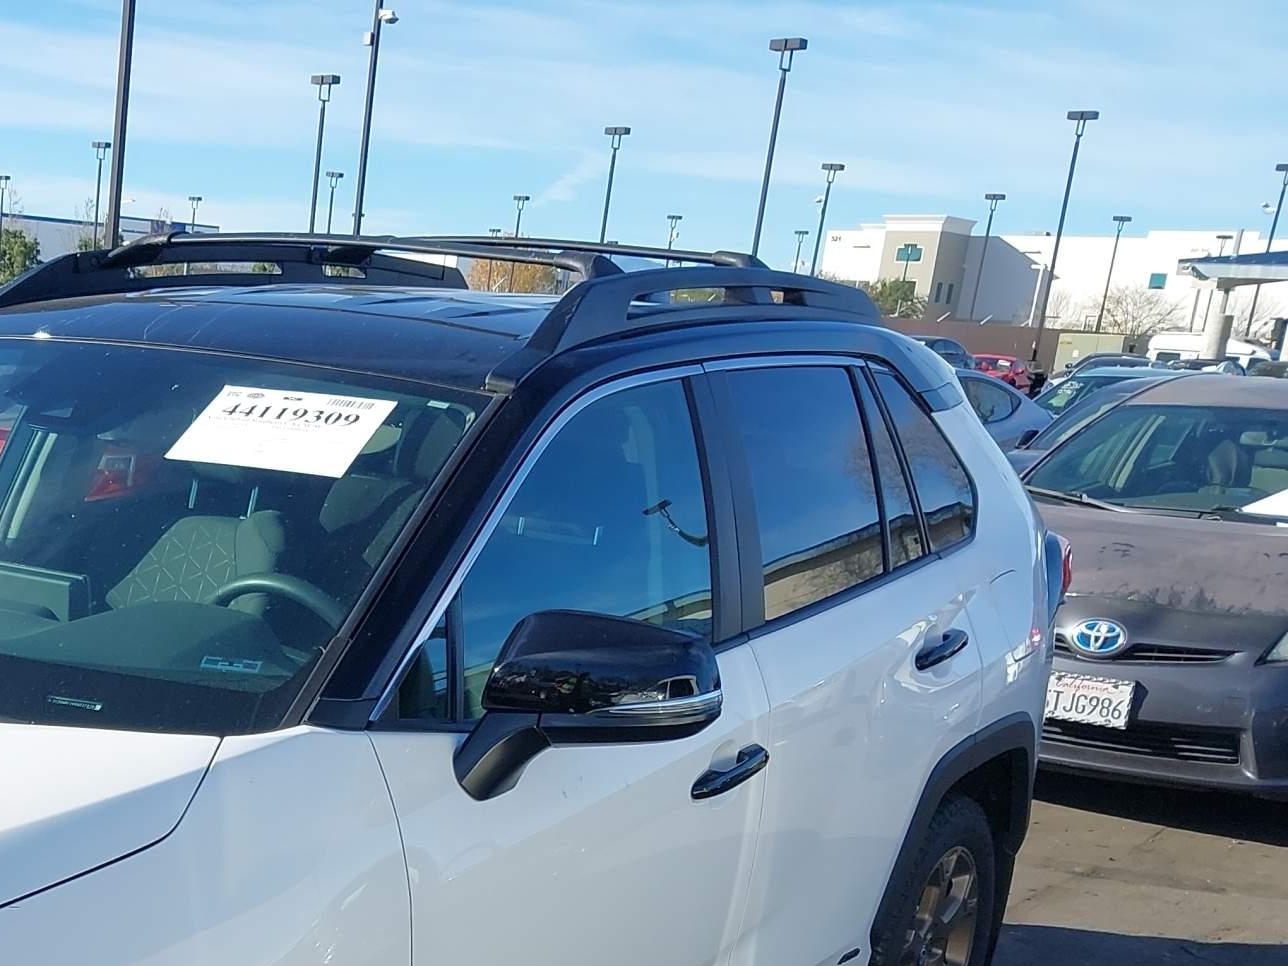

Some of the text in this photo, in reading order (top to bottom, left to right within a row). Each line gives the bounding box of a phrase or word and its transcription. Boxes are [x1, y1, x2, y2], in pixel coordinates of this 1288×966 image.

[222, 403, 360, 427] 44119309
[1055, 679, 1115, 694] California
[1047, 690, 1125, 720] TJG986
